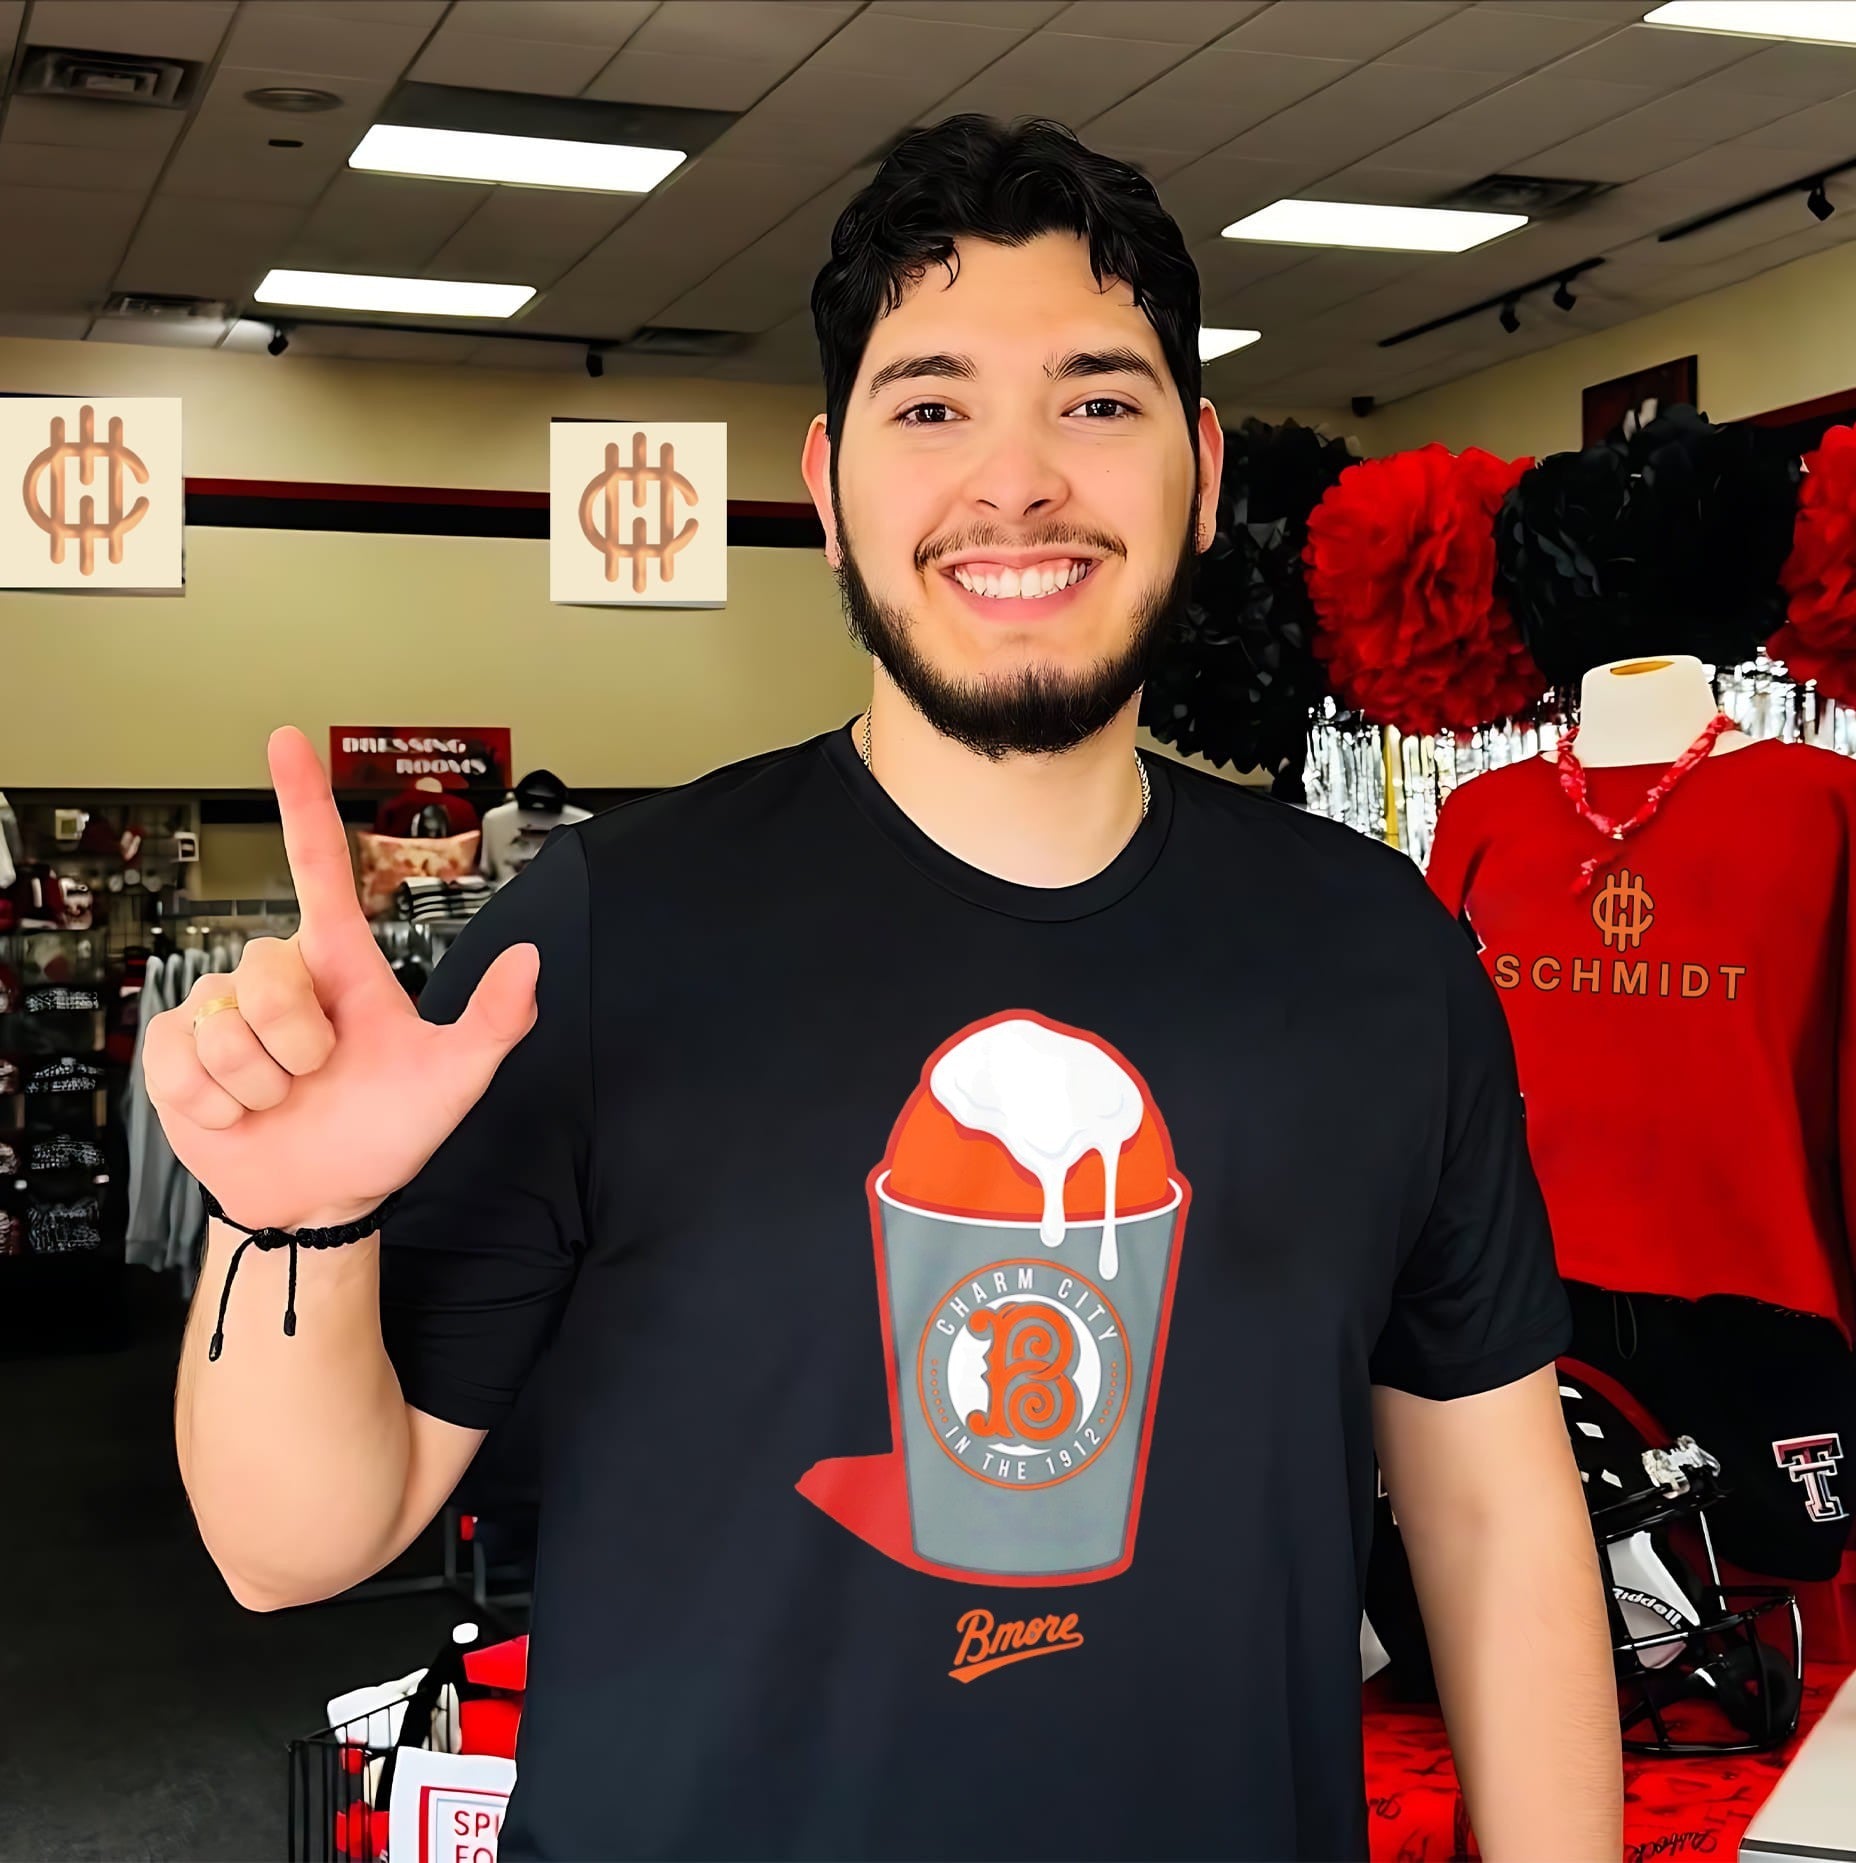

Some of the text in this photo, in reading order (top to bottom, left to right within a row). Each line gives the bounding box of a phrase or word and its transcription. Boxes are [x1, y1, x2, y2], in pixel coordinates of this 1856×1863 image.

[396, 758, 487, 775] ROOMS
[1494, 954, 1746, 1000] SCHMIDT
[935, 1267, 1118, 1341] CHARM CITY
[965, 1303, 1076, 1442] B
[945, 1425, 1101, 1480] IN THE 1912
[948, 1608, 1085, 1684] Bmore
